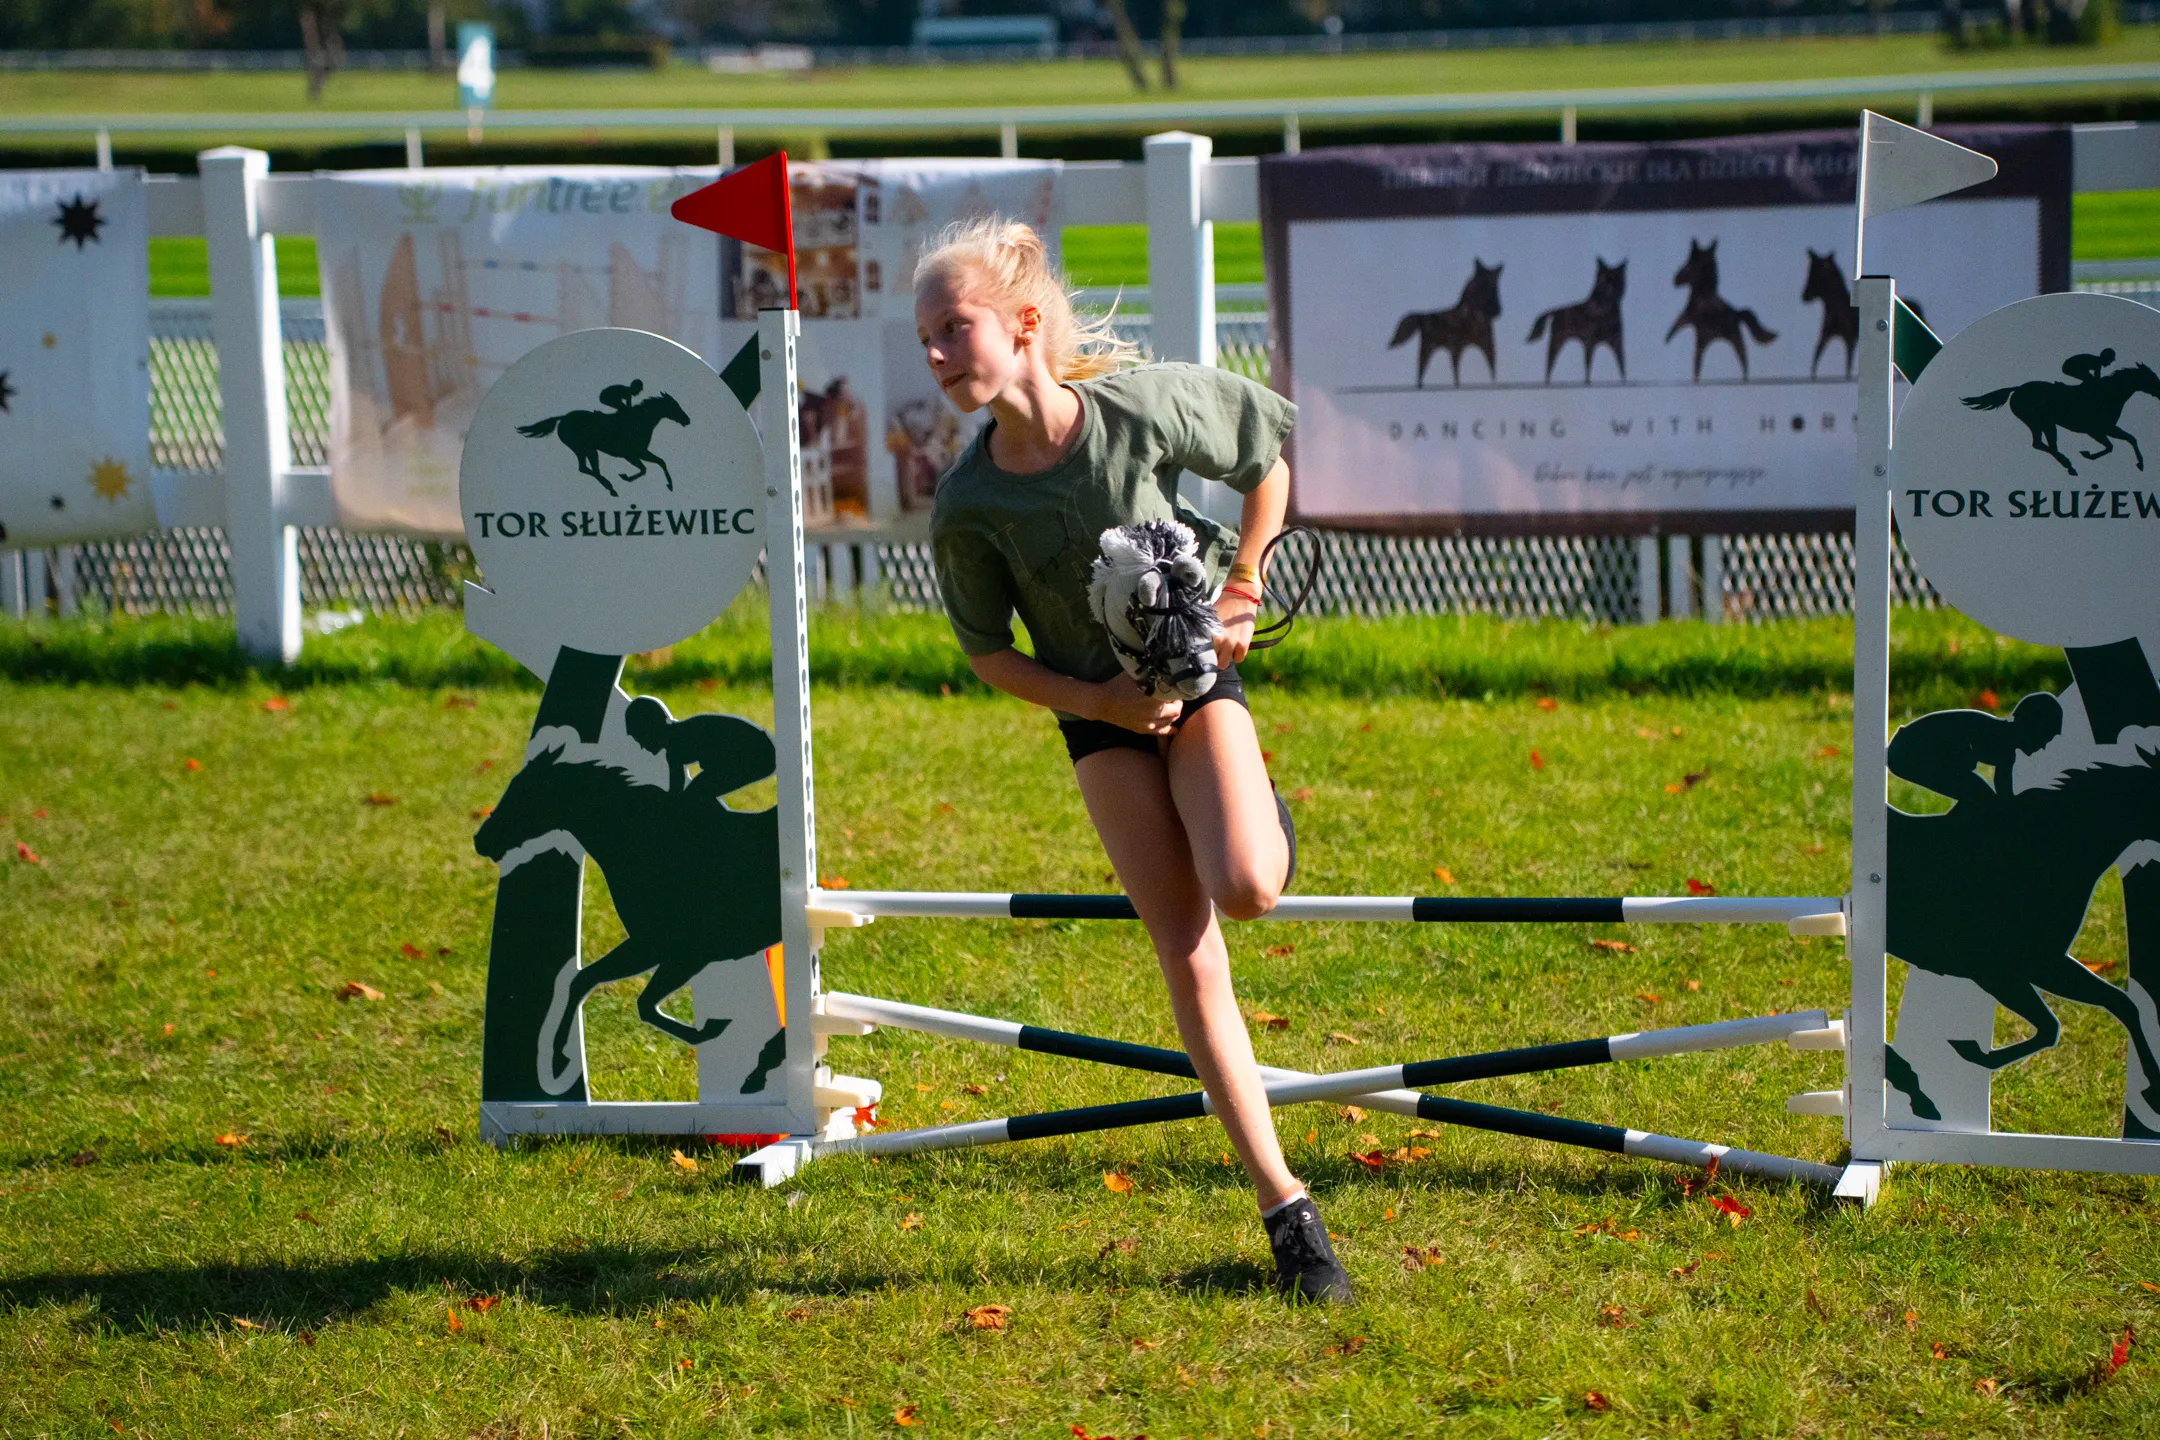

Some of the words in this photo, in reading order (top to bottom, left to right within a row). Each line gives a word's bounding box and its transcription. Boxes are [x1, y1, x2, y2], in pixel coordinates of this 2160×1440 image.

[457, 35, 496, 98] 4
[1388, 416, 1567, 442] DANCING
[1610, 414, 1713, 437] WITH
[1905, 489, 1994, 518] TOR
[474, 512, 550, 538] TOR
[562, 503, 756, 537] SŁUŻEWIEC
